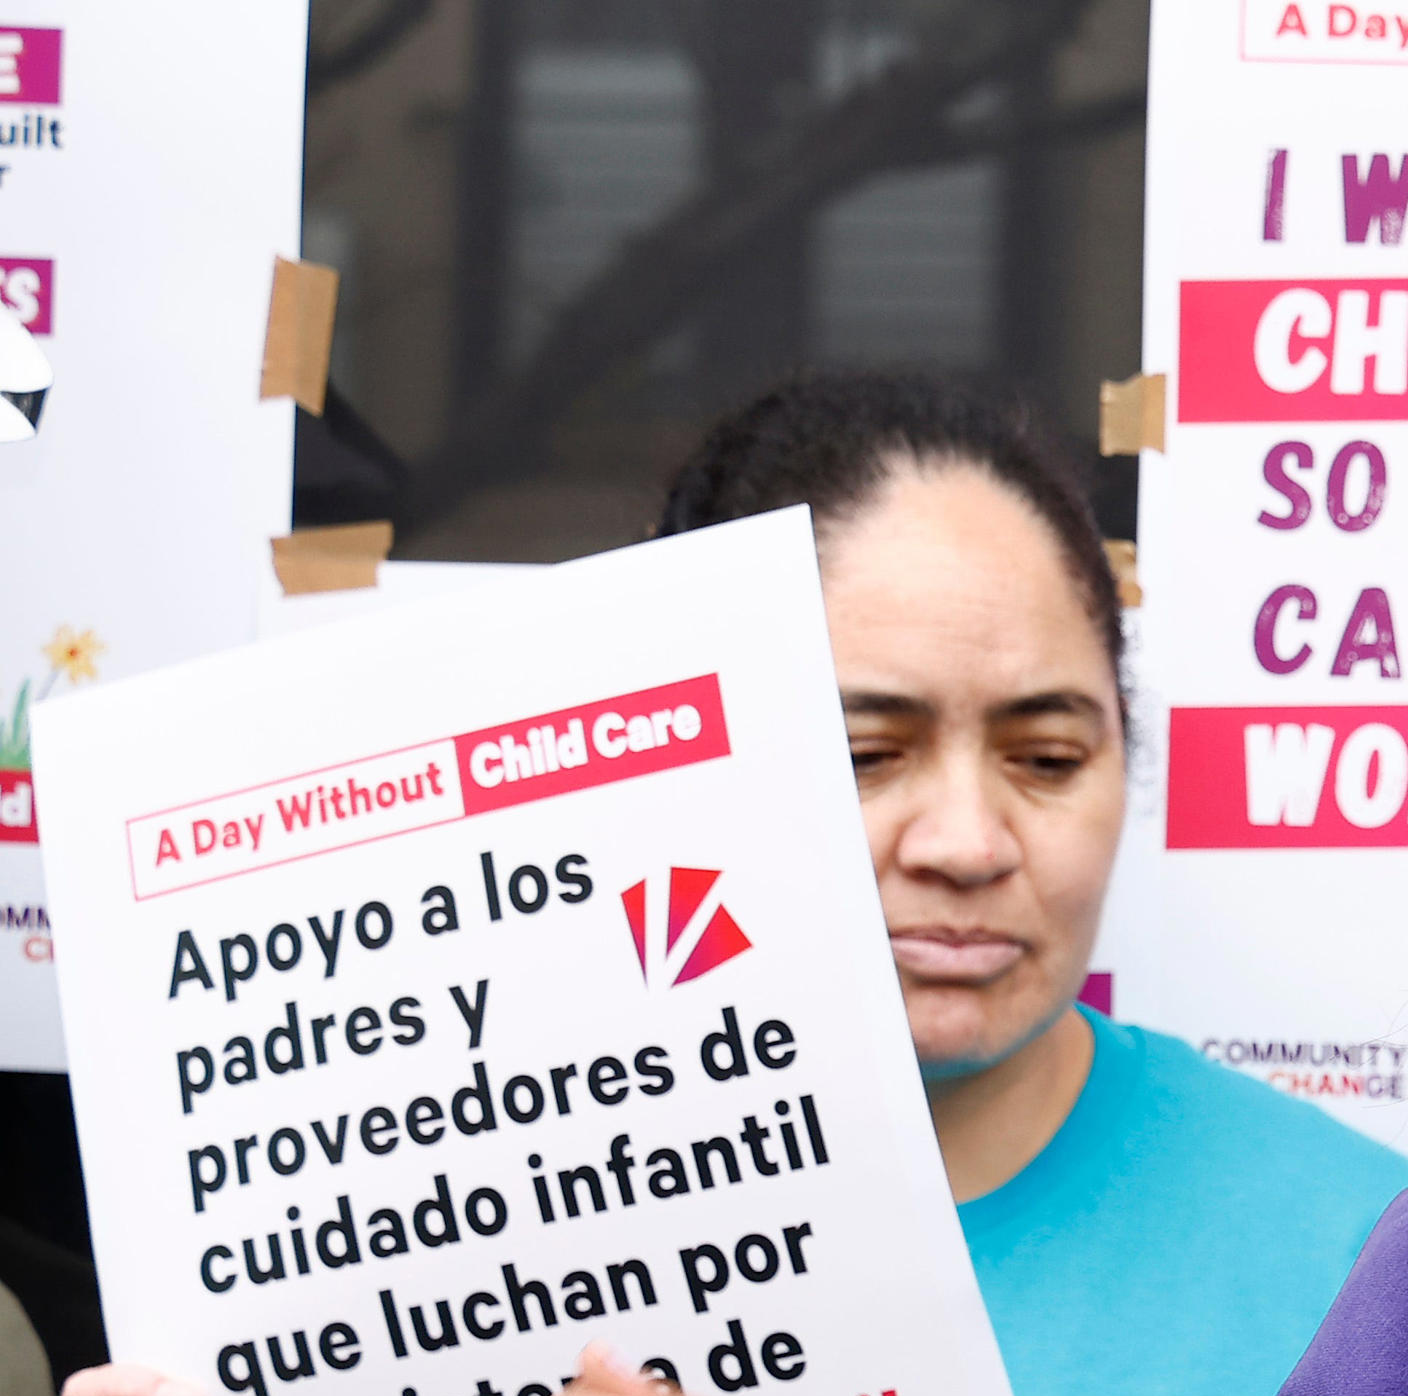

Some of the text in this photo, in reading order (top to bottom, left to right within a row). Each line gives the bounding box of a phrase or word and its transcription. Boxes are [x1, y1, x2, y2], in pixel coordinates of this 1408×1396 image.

[1275, 2, 1308, 38] A
[0, 114, 62, 149] uilt
[1262, 148, 1289, 242] I
[1257, 439, 1388, 535] SO
[155, 704, 702, 868] A Day Without Child Care
[168, 851, 594, 1002] Apoyo a los
[176, 979, 489, 1115] padres y
[187, 1005, 797, 1214] proveedores de
[200, 1094, 830, 1294] cuidado infantil
[378, 1258, 659, 1359] luchan
[678, 1221, 813, 1314] por
[707, 1318, 807, 1393] de
